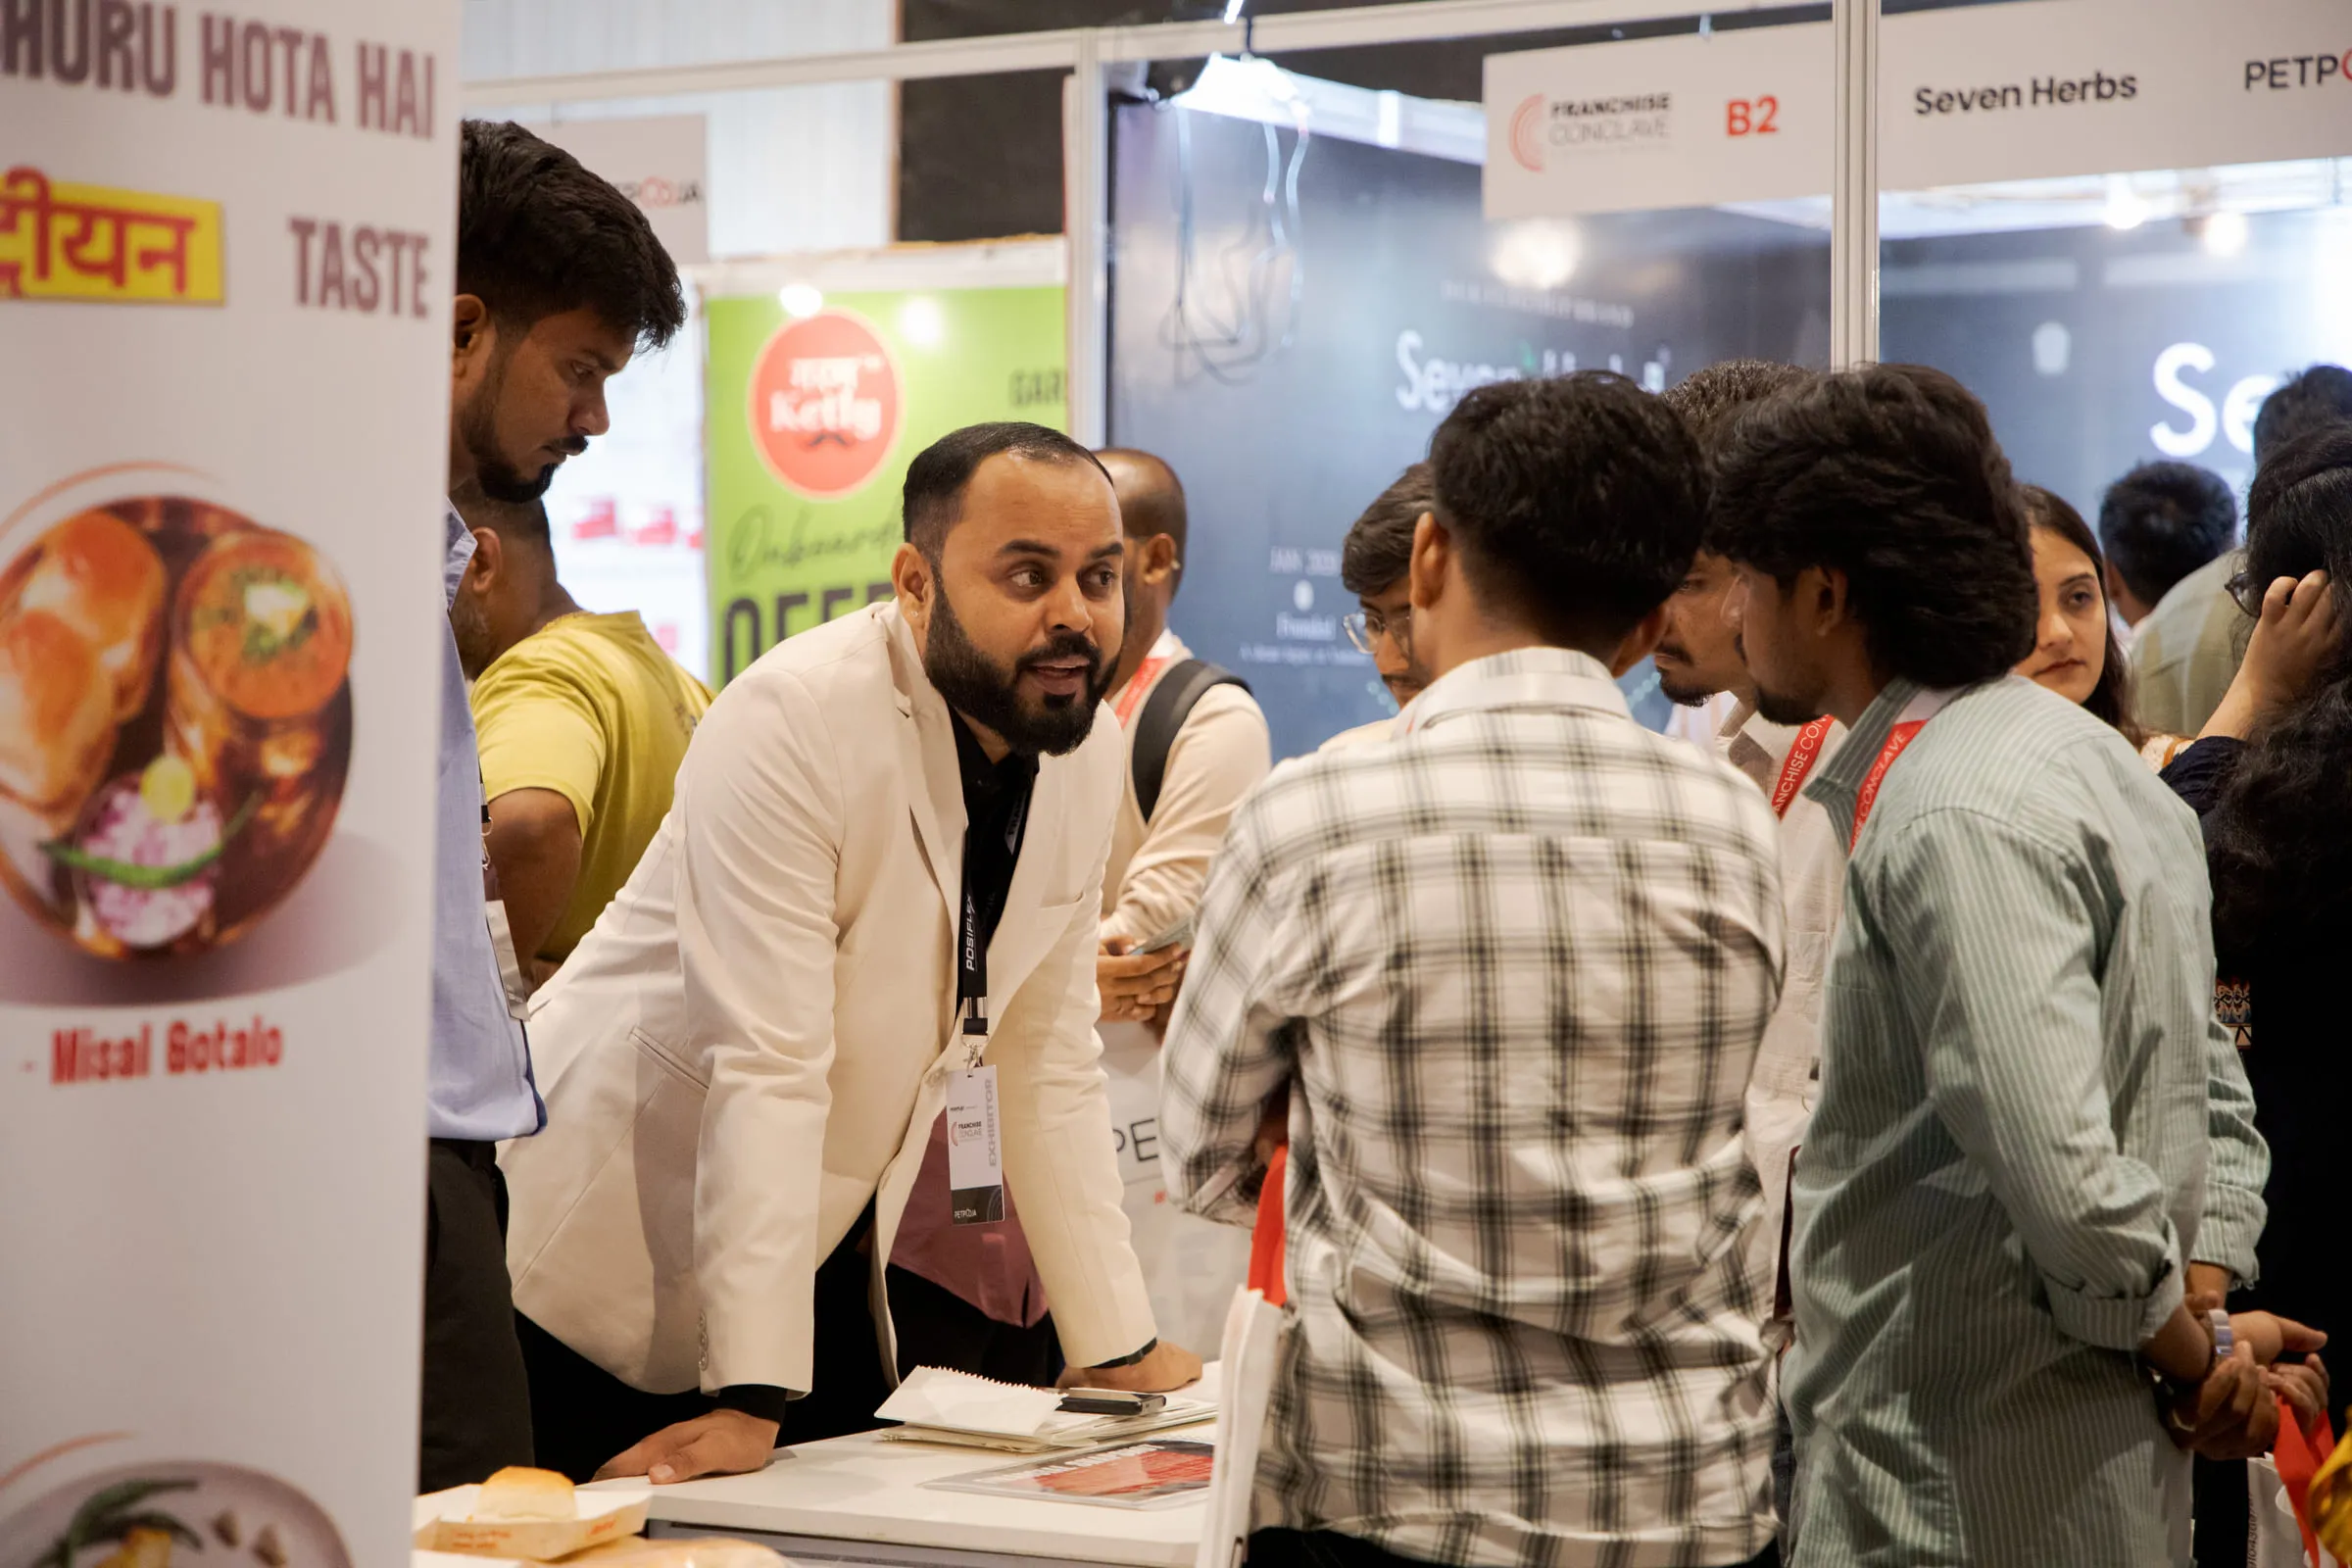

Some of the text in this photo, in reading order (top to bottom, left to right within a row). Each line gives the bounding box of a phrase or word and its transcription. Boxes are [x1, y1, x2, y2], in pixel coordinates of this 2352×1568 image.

[200, 14, 337, 125] HOTA
[357, 40, 435, 140] HAI
[1726, 96, 1779, 136] B2
[1915, 70, 2138, 115] Seven Herbs
[288, 215, 429, 318] TASTE
[965, 893, 977, 972] POSIFLEX
[985, 1079, 997, 1167] EXHIBITOR
